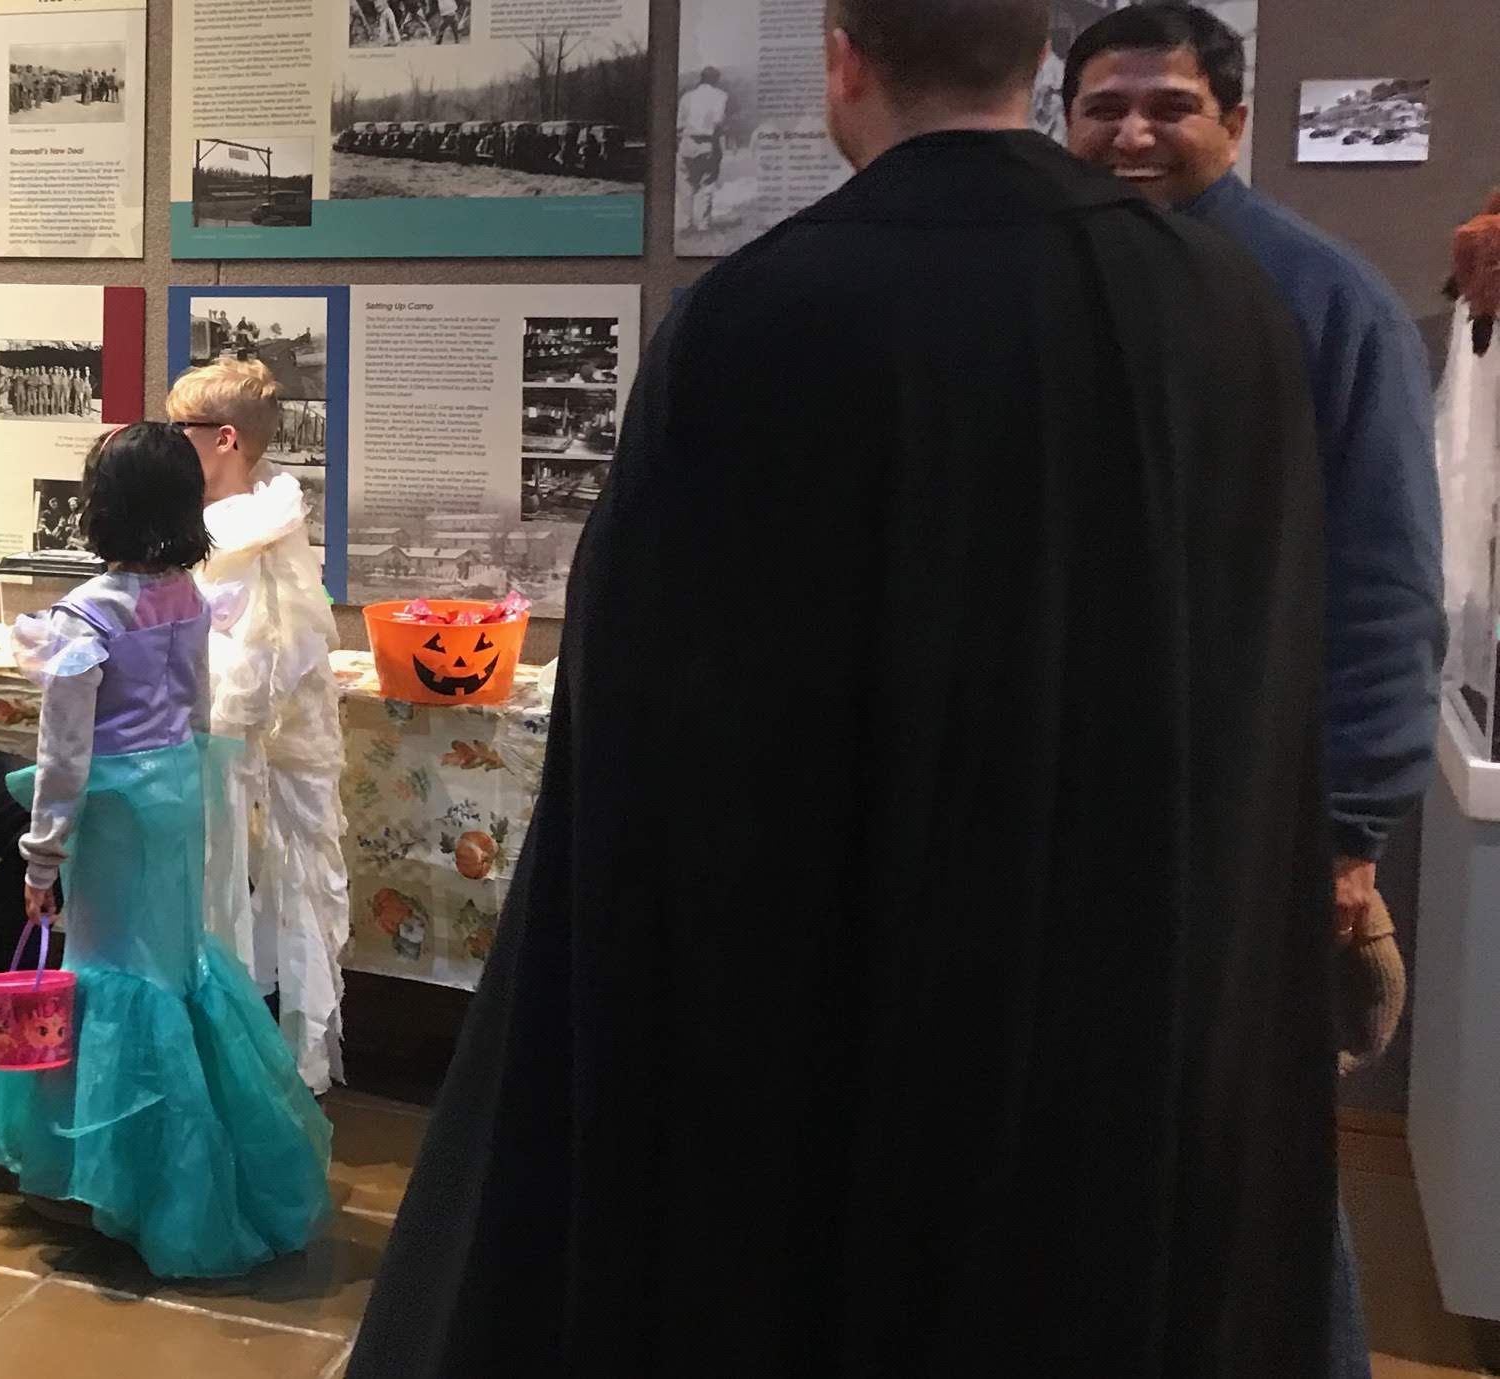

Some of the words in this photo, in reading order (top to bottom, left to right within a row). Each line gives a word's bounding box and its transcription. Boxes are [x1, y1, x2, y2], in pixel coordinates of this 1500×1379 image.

[49, 147, 65, 155] New
[67, 147, 84, 155] Deal
[365, 302, 393, 311] Setting
[394, 302, 406, 311] Up
[407, 302, 434, 311] Camp
